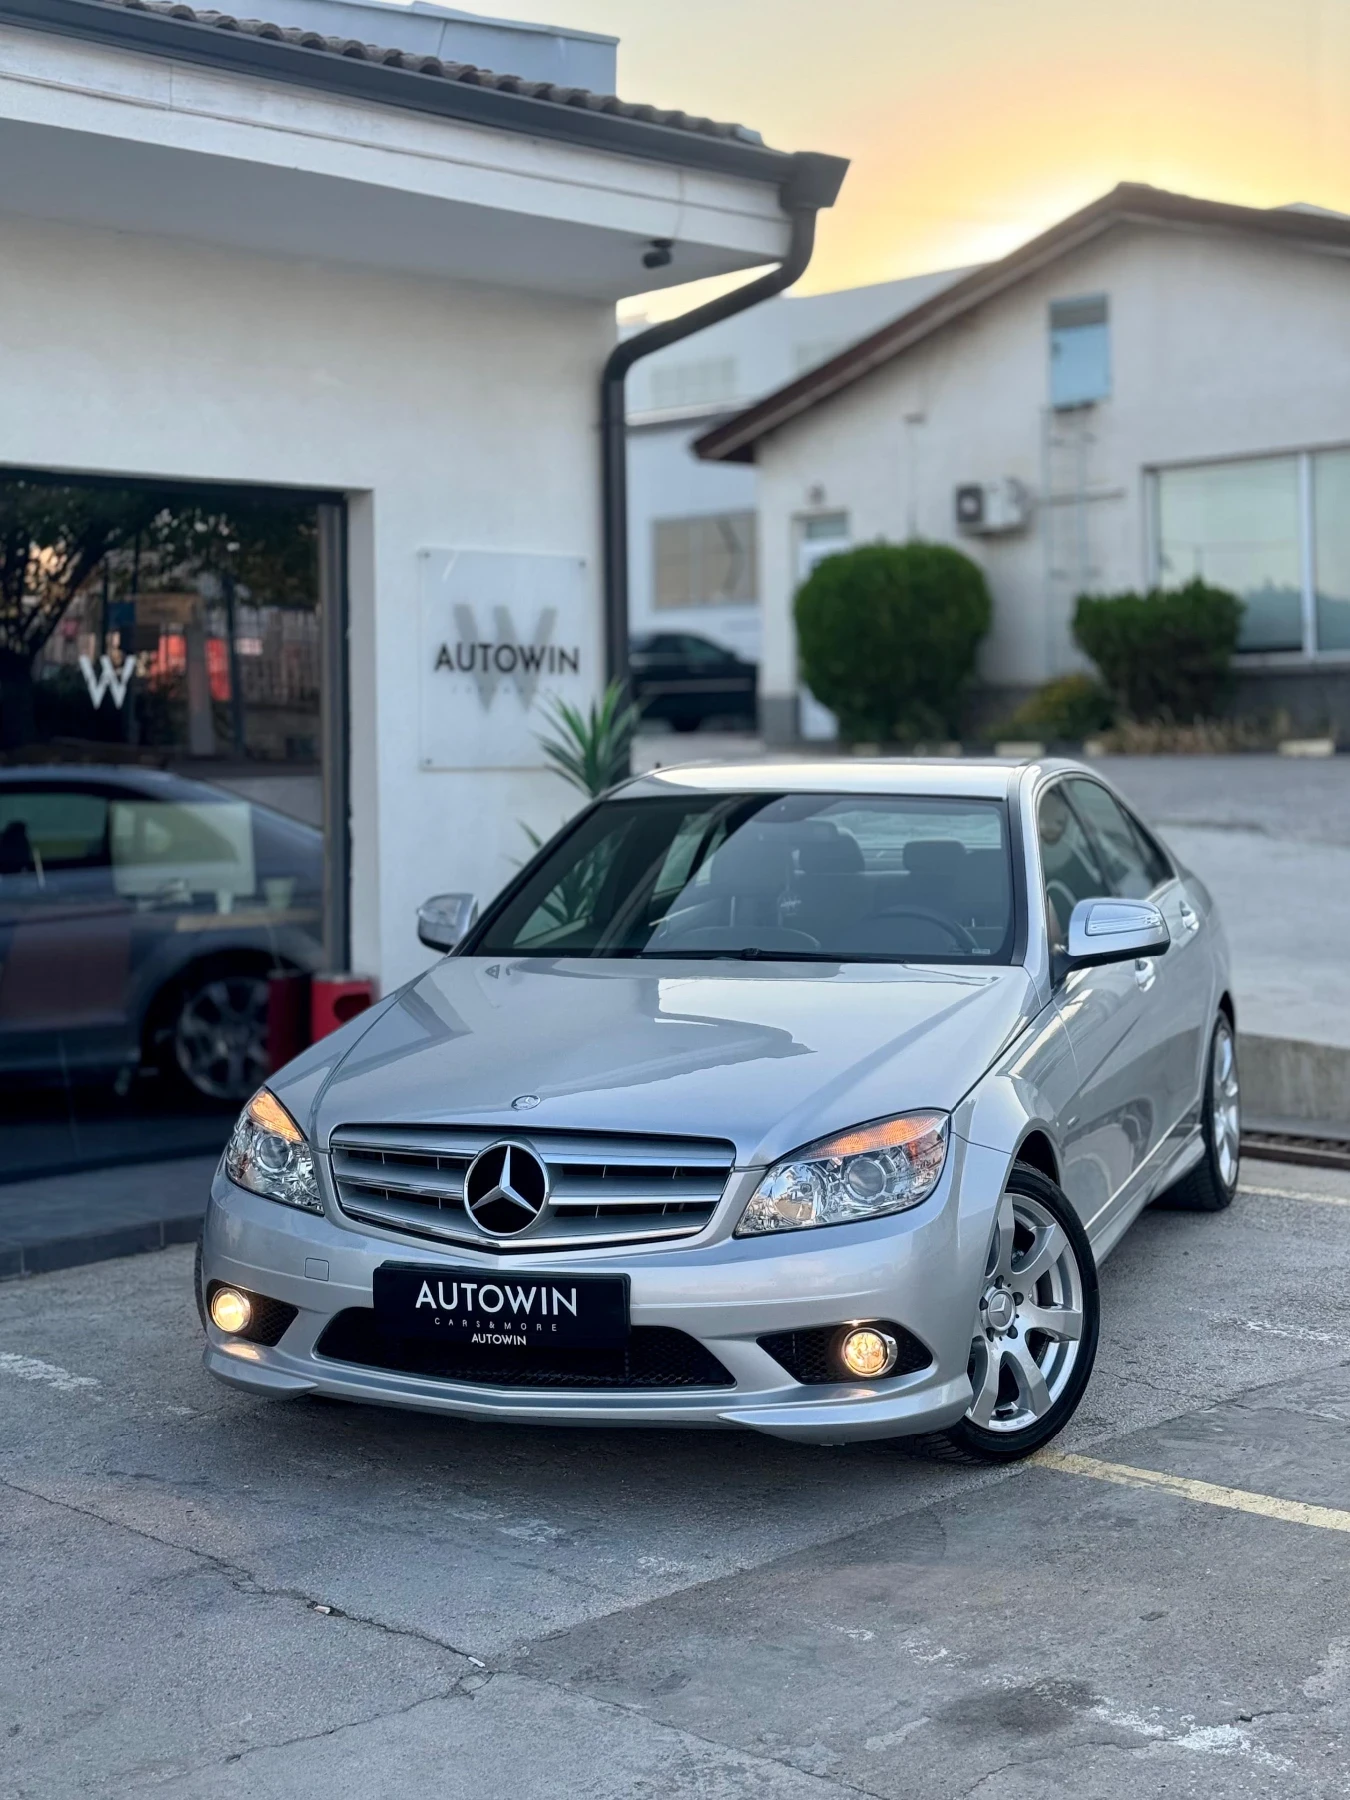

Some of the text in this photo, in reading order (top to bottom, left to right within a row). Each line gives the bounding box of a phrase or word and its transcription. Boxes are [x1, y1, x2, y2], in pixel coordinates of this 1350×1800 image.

[434, 642, 580, 675] AUTOWIN
[79, 654, 137, 710] W
[415, 1280, 578, 1316] AUTOWIN
[471, 1332, 527, 1346] AUTOWIN
